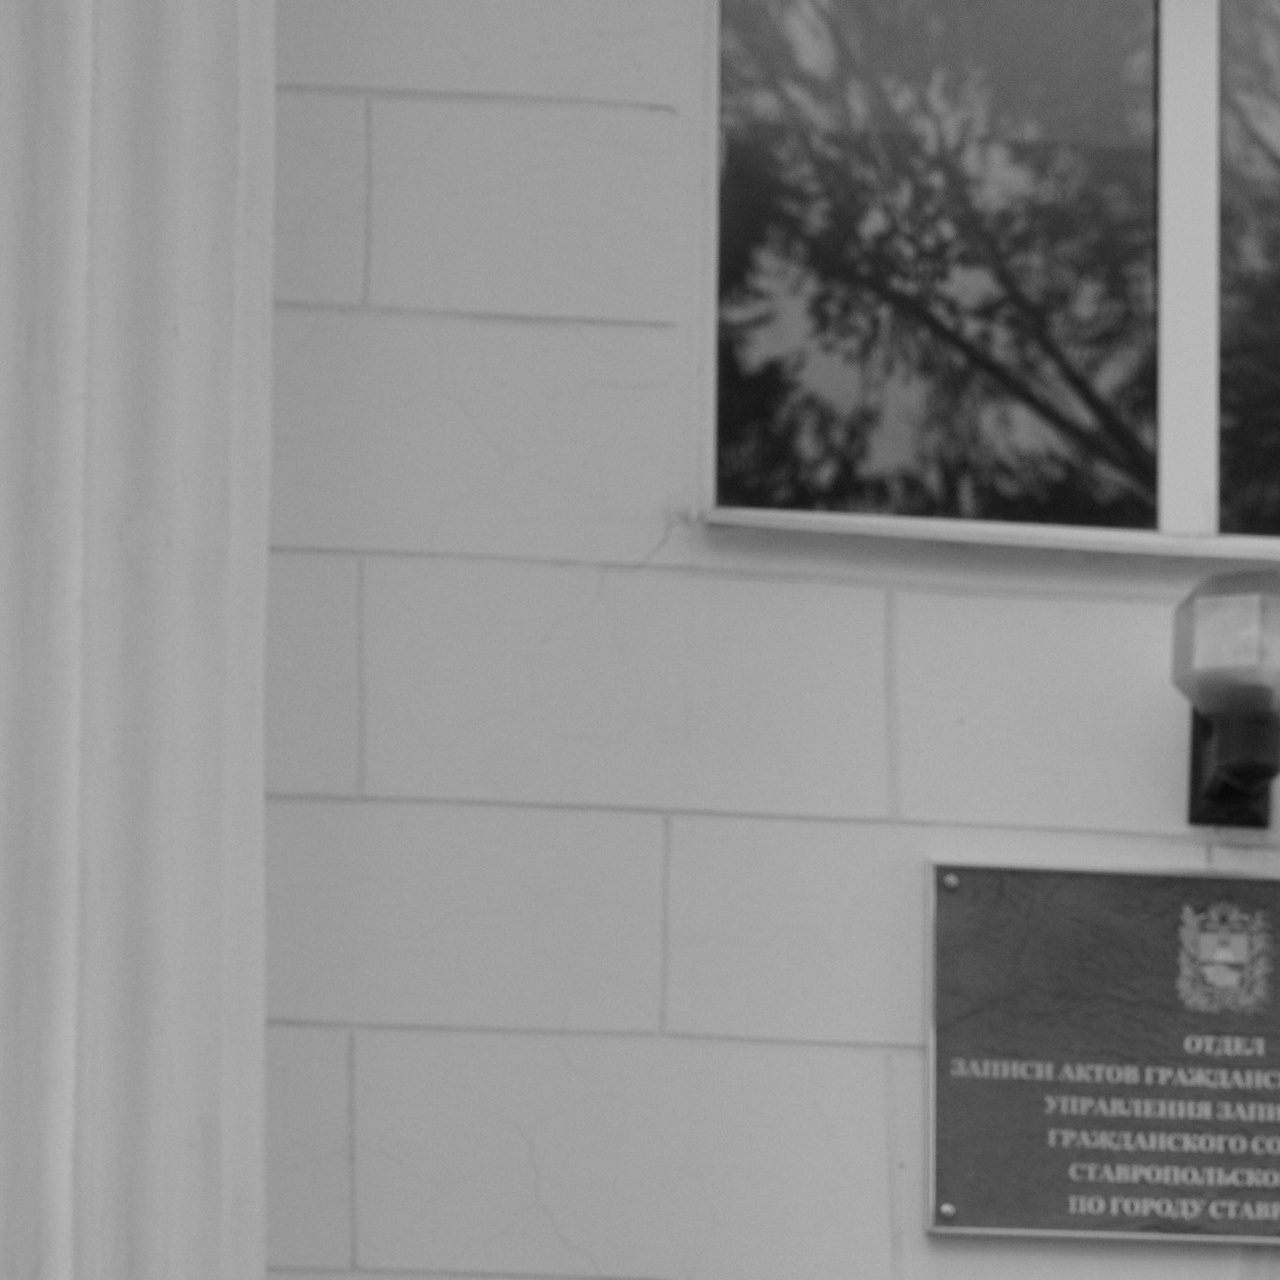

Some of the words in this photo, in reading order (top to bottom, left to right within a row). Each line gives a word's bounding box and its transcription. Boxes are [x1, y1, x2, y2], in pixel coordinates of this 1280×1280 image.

[1184, 1034, 1267, 1057] ОТДЕЛ
[950, 1057, 1055, 1082] ЗАПИСИ
[1059, 1062, 1140, 1085] АКТОВ
[1044, 1095, 1212, 1120] УПРАВЛЕНИЯ
[1047, 1128, 1247, 1155] ГРАЖДАНСКОГО
[1068, 1195, 1105, 1216] ПО
[1109, 1197, 1206, 1220] ГОРОДУ
